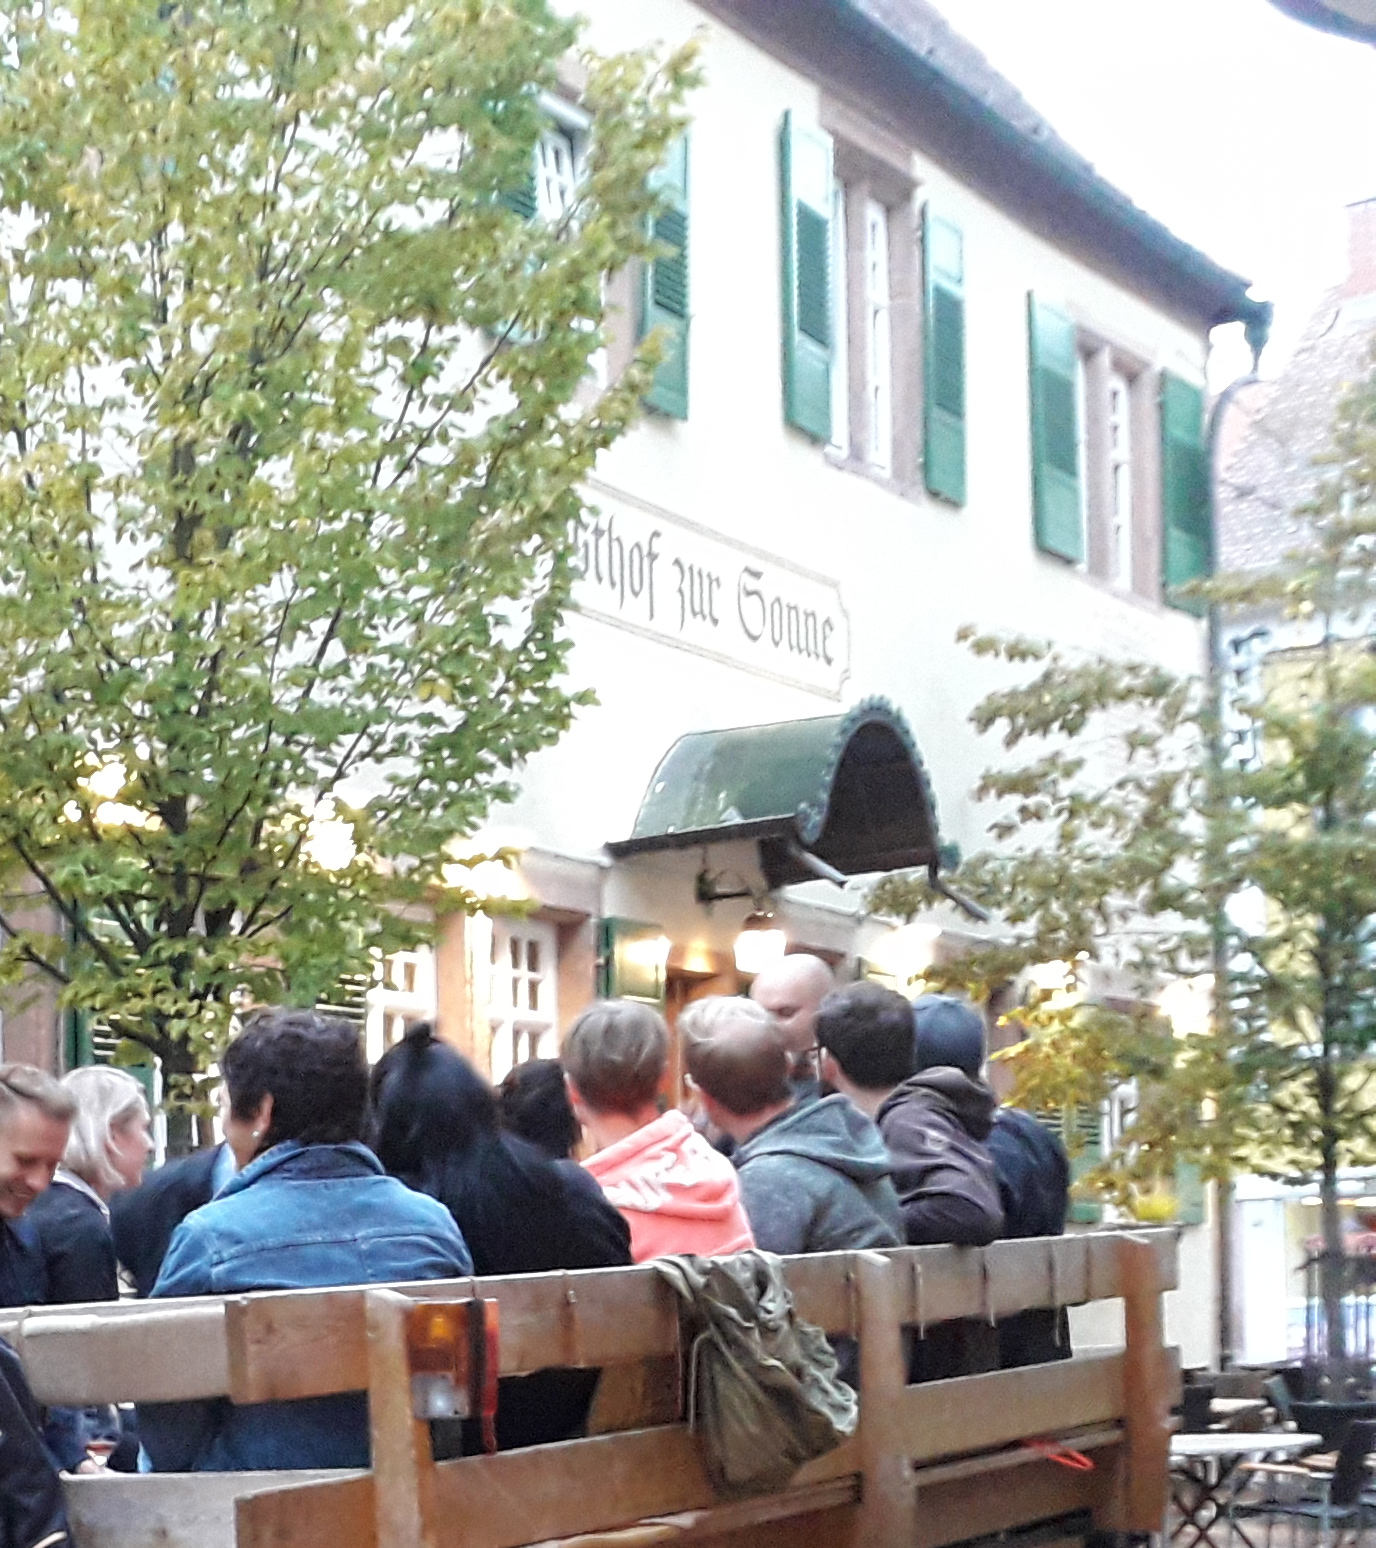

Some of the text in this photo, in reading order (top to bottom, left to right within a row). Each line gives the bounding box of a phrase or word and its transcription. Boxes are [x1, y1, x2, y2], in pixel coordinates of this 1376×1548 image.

[572, 512, 835, 667] sthof zur Sonne
